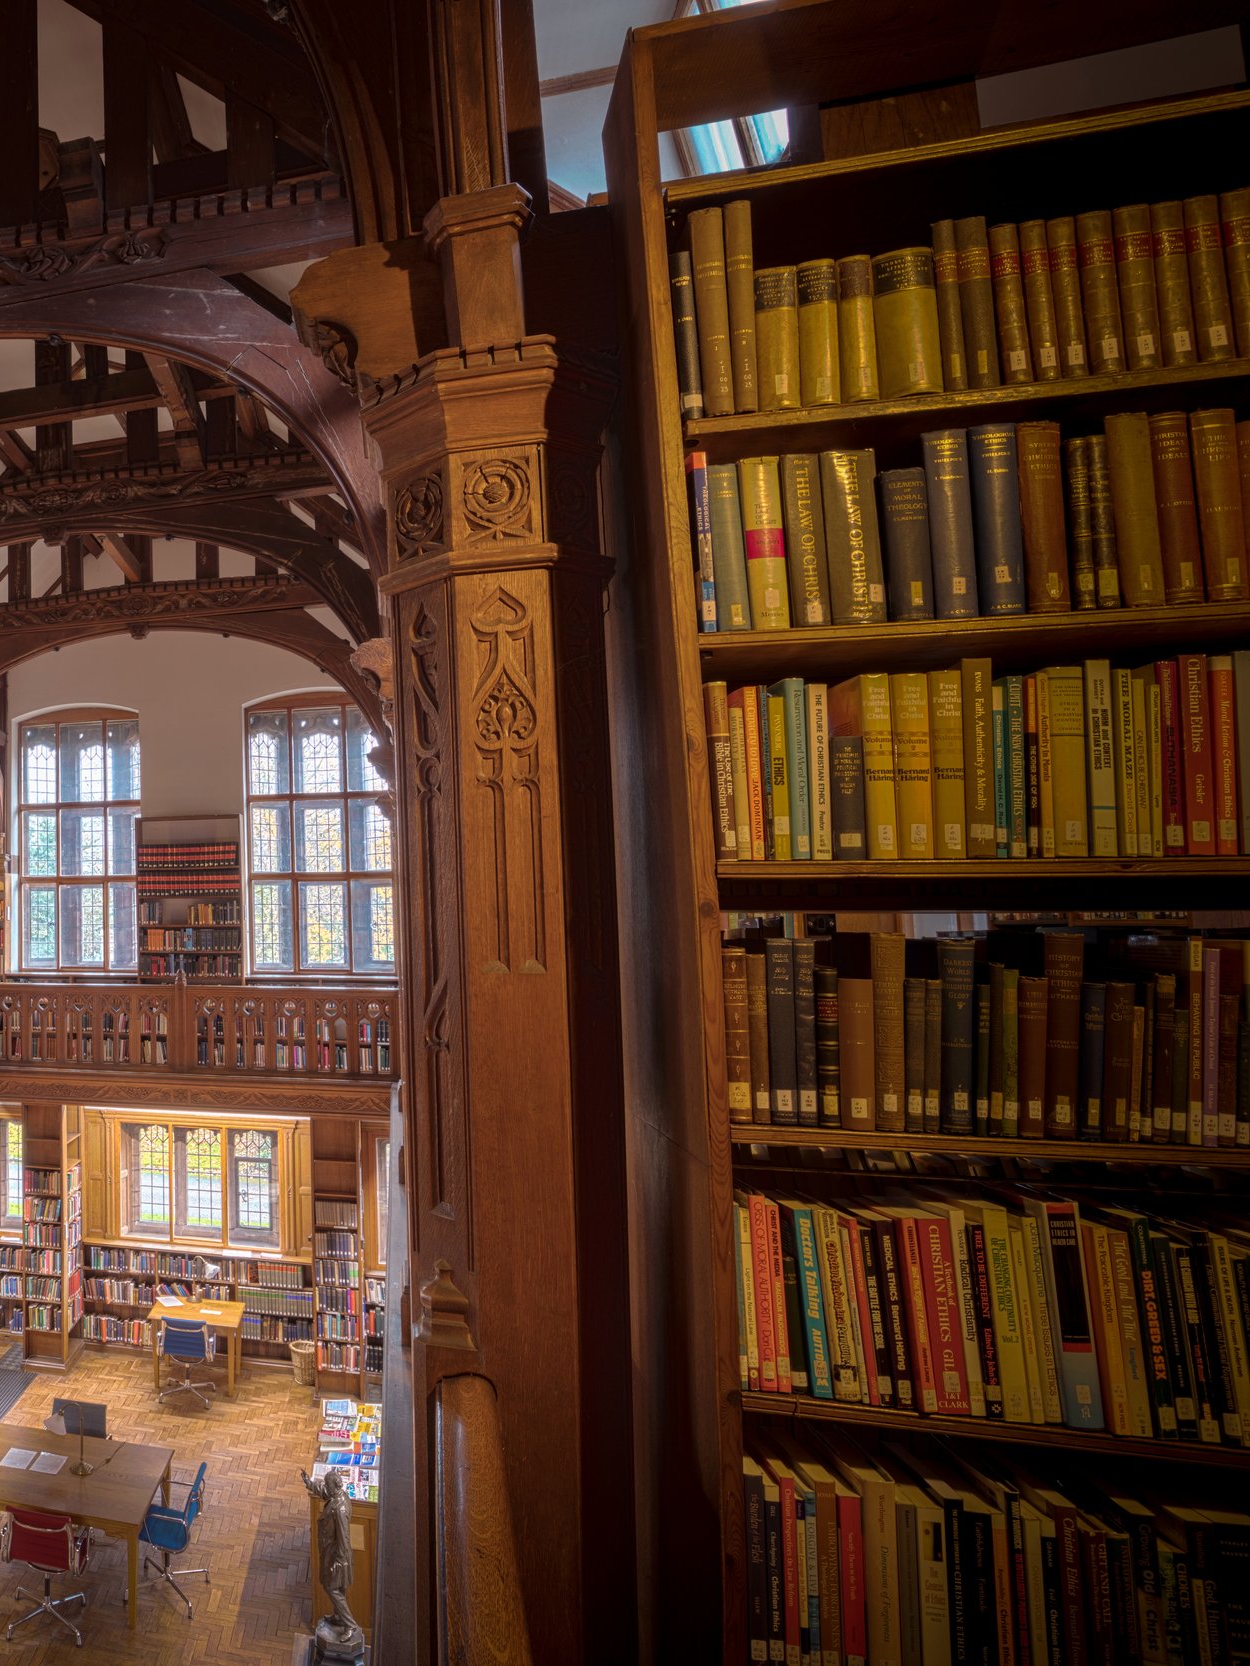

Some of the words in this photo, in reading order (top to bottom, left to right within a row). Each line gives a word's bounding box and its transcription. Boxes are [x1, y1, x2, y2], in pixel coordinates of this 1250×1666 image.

[795, 467, 811, 498] THE
[846, 462, 860, 492] THE
[888, 481, 925, 489] ELEMENTS
[887, 502, 928, 512] THEOLOGY
[892, 493, 923, 501] MORAL
[798, 499, 814, 531] LAW
[848, 494, 863, 526] LAW
[801, 533, 816, 556] OF
[850, 528, 864, 550] OF
[851, 550, 869, 604] CHRIST
[869, 686, 885, 694] Free
[940, 689, 957, 697] and
[974, 671, 982, 692] EVANS
[1121, 672, 1129, 697] THE
[1187, 658, 1201, 712] Christian
[745, 689, 755, 704] The
[975, 697, 985, 718] Faith,
[1010, 683, 1020, 707] CUPITT
[793, 689, 803, 741] Resurrection
[815, 708, 823, 732] FUTURE
[937, 709, 961, 717] Christ
[1101, 708, 1109, 726] NORM
[1122, 699, 1131, 743] MORAL
[1221, 699, 1230, 721] Moral
[746, 706, 757, 744] Capacity
[1011, 716, 1021, 732] THE
[1041, 714, 1049, 748] Authority
[1091, 716, 1101, 748] CHRISTIAN
[1102, 728, 1110, 741] and
[1190, 716, 1203, 752] Ethics
[1221, 723, 1230, 748] Action
[714, 741, 725, 761] Bible
[723, 741, 731, 754] The
[749, 746, 758, 756] to
[796, 741, 804, 753] and
[816, 735, 823, 744] OF
[897, 737, 927, 745] Volume
[975, 719, 986, 768] Authenticity
[1011, 733, 1021, 750] NEW
[817, 745, 825, 782] CHRISTIAN
[1093, 748, 1102, 770] ETHICS
[1102, 742, 1112, 768] CONTEXT
[1124, 744, 1133, 779] MAZE
[1222, 749, 1230, 757] &
[750, 757, 759, 778] Love
[773, 757, 785, 785] ETHICS
[796, 757, 805, 778] Moral
[897, 768, 930, 776] Bernard
[1012, 751, 1022, 788] CHRISTIAN
[1042, 758, 1050, 782] Morals
[1223, 758, 1232, 793] Christian
[716, 768, 728, 806] Christian
[797, 780, 805, 803] Order
[976, 777, 986, 811] Morality
[1194, 773, 1205, 804] Geisler
[1013, 789, 1023, 815] ETHICS
[1224, 795, 1233, 817] Ethics
[720, 807, 730, 832] Ethics
[753, 799, 761, 840] DOMINIAN
[1049, 954, 1081, 962] HISTORY
[1051, 980, 1080, 988] ETHICS
[1192, 992, 1200, 1036] BEHAVING
[1192, 1041, 1200, 1050] IN
[1192, 1051, 1200, 1080] PUBLIC
[753, 1201, 764, 1225] CRISIS
[755, 1228, 765, 1240] OF
[798, 1217, 816, 1267] Doctors
[975, 1230, 984, 1249] FREE
[991, 1237, 999, 1246] OF
[998, 1238, 1007, 1252] THE
[1029, 1222, 1040, 1245] John
[1097, 1234, 1106, 1249] The
[756, 1242, 767, 1273] MORAL
[882, 1235, 895, 1270] MEDICAL
[928, 1224, 946, 1292] CHRISTIAN
[976, 1251, 985, 1263] TO
[1114, 1239, 1128, 1257] The
[773, 1257, 781, 1277] MEDIA
[960, 1258, 971, 1290] Radical
[978, 1264, 986, 1273] BE
[992, 1247, 1003, 1286] CHRISTIAN
[1000, 1253, 1012, 1289] CHANGING
[1098, 1250, 1110, 1287] Peaceable
[1116, 1257, 1130, 1280] Good
[867, 1275, 878, 1287] THE
[886, 1272, 898, 1301] ETHICS
[944, 1266, 955, 1297] Textbook
[1119, 1282, 1132, 1300] and
[1142, 1270, 1155, 1301] DIRT,
[758, 1277, 771, 1325] AUTHORITY
[803, 1270, 821, 1319] Talking
[868, 1287, 880, 1309] BATTLE
[948, 1298, 956, 1306] of
[978, 1274, 991, 1318] DIFFERENT
[996, 1286, 1006, 1311] ETHICS
[1102, 1288, 1114, 1323] Kingdom
[871, 1310, 882, 1322] FOR
[890, 1304, 903, 1341] Bernard
[936, 1296, 952, 1342] ETHICS
[963, 1292, 976, 1342] Christianity
[1004, 1290, 1017, 1333] CONTINUITY
[1037, 1300, 1049, 1327] Three
[1121, 1303, 1134, 1320] the
[1145, 1300, 1161, 1344] GREED
[761, 1329, 772, 1345] Don
[873, 1322, 883, 1333] THE
[983, 1327, 994, 1347] Edited
[1123, 1321, 1136, 1341] True
[1229, 1319, 1239, 1345] Norman
[874, 1333, 885, 1349] SOUL
[985, 1347, 995, 1359] by
[1040, 1327, 1052, 1357] Issues
[1151, 1345, 1162, 1354] &
[894, 1342, 906, 1370] Häring
[986, 1359, 997, 1377] John
[1044, 1357, 1053, 1366] in
[1152, 1355, 1166, 1381] SEX
[1233, 1346, 1244, 1377] Anderson
[1045, 1367, 1057, 1396] Ethics
[939, 1400, 969, 1409] CLARK
[807, 1521, 816, 1560] FORGIVE
[828, 1521, 837, 1580] EMBODYING
[1063, 1517, 1076, 1563] Christian
[1138, 1523, 1151, 1567] Growing
[881, 1545, 890, 1588] Dimensions
[1098, 1543, 1108, 1565] GIFT
[771, 1575, 779, 1609] Christian
[809, 1574, 817, 1593] LIVE
[1066, 1566, 1078, 1597] Ethics
[1099, 1571, 1109, 1593] AND
[1142, 1568, 1155, 1593] Old
[1175, 1562, 1191, 1609] CHOICES
[1205, 1580, 1218, 1606] God,
[953, 1570, 964, 1623] CHRISTIAN
[772, 1610, 780, 1632] Ethics
[829, 1583, 839, 1648] FORGIVENESS
[882, 1600, 891, 1642] Forgiveness
[1146, 1609, 1159, 1650] Christ
[956, 1625, 966, 1660] ETHICS
